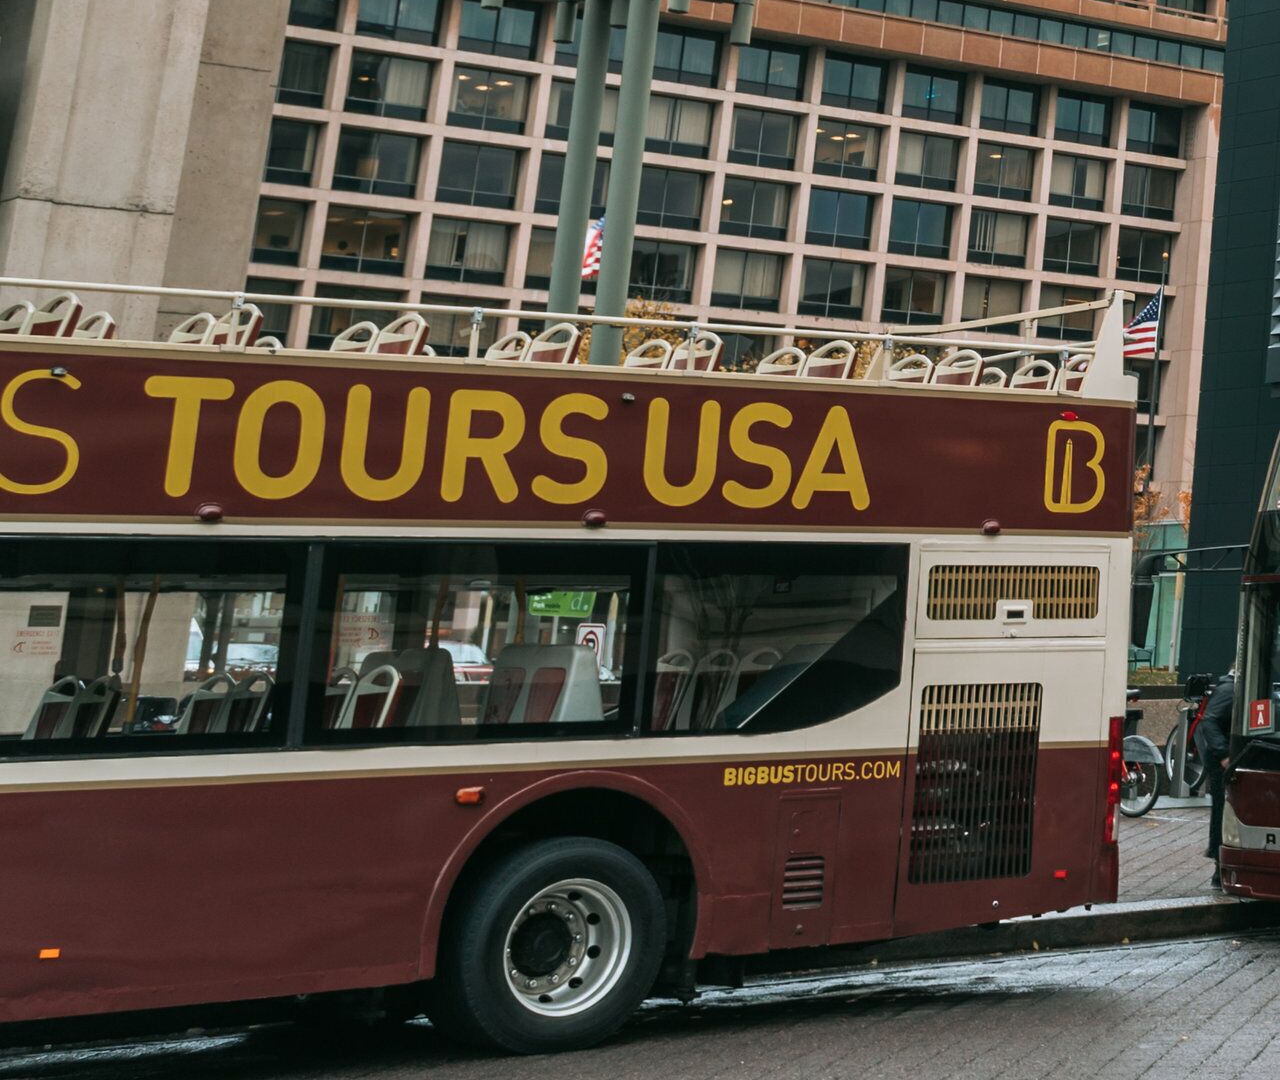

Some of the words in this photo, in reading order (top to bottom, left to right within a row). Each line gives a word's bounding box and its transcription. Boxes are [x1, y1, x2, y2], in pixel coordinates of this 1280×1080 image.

[145, 375, 608, 504] TOURS
[643, 397, 871, 511] USA
[1257, 712, 1265, 725] A
[723, 761, 901, 786] BIGBUSTOURS.COM
